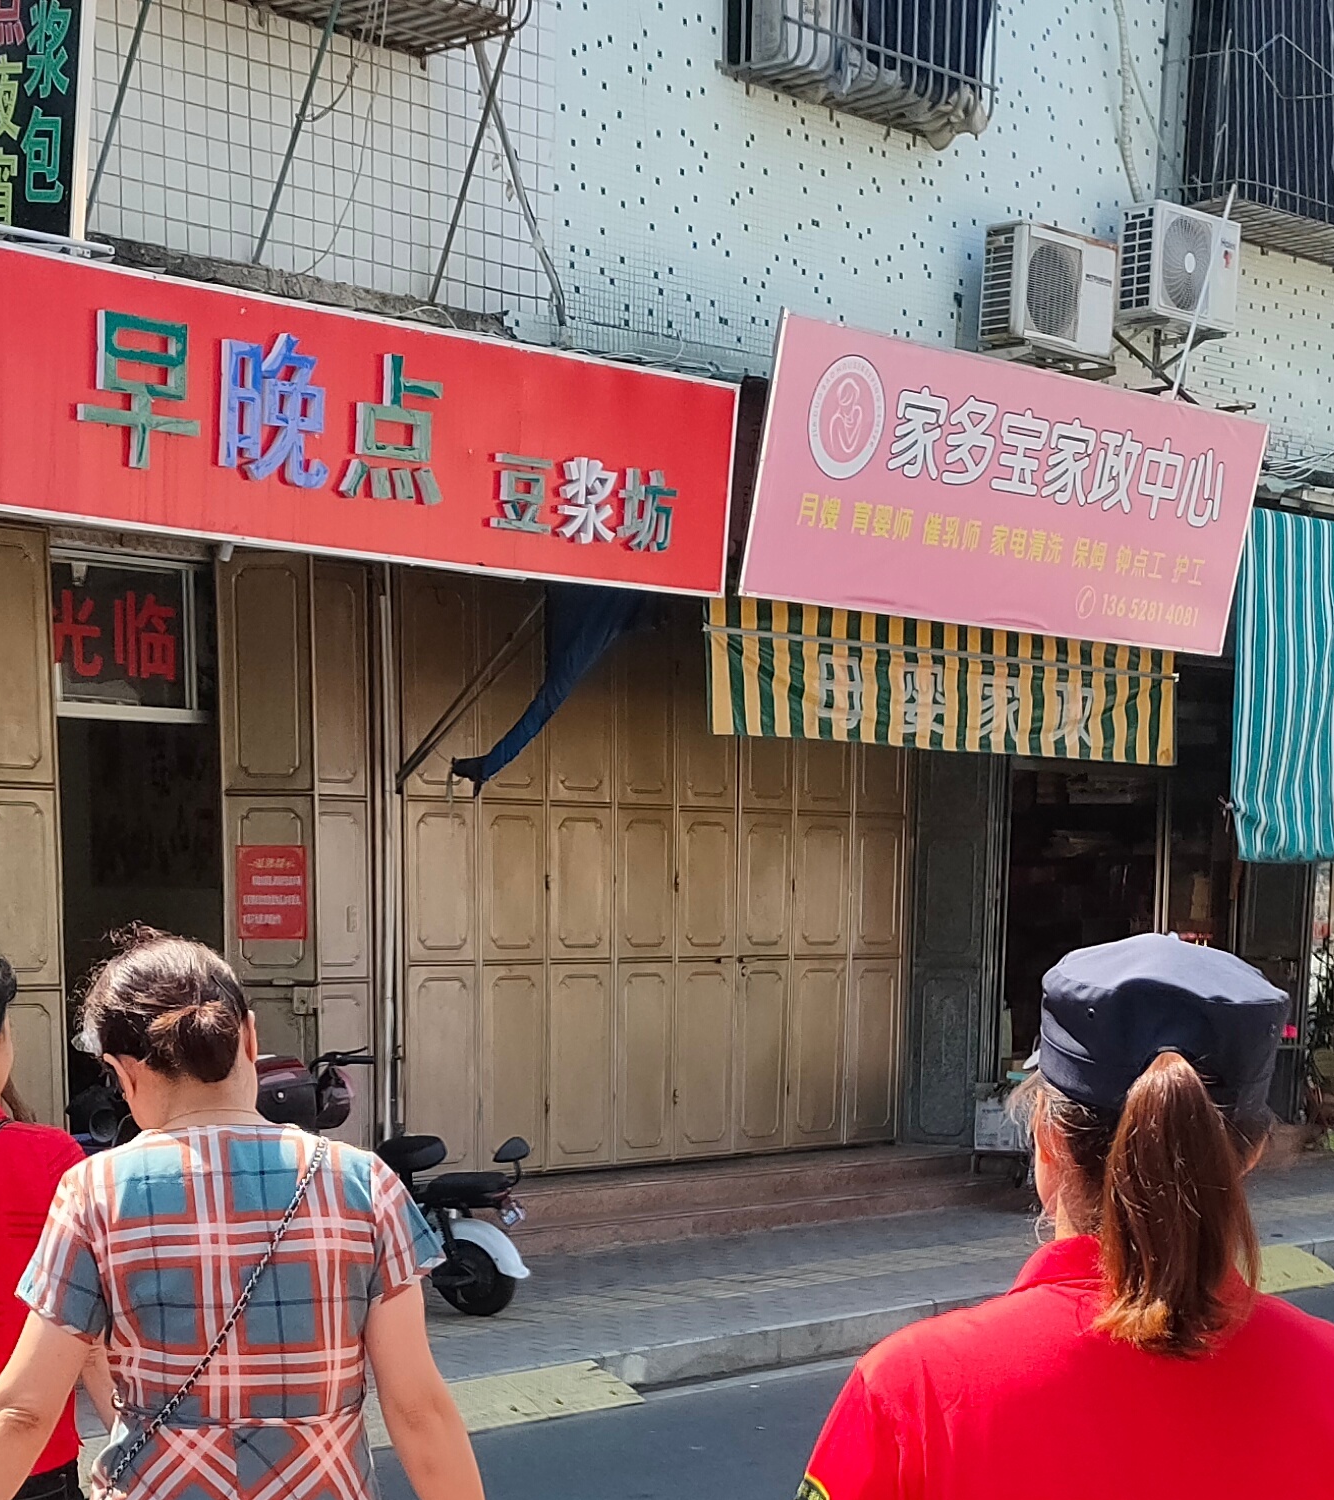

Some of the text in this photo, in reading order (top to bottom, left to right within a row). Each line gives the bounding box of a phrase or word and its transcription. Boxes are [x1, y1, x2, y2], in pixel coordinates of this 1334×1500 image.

[77, 308, 444, 505] 早晚点
[490, 450, 679, 553] 豆浆坊
[886, 386, 1225, 528] 家多宝家政中心
[796, 492, 1206, 586] 月嫂 育婴师 催乳师 家电清洗 保姆 钟点工 护工
[53, 589, 176, 680] 光临
